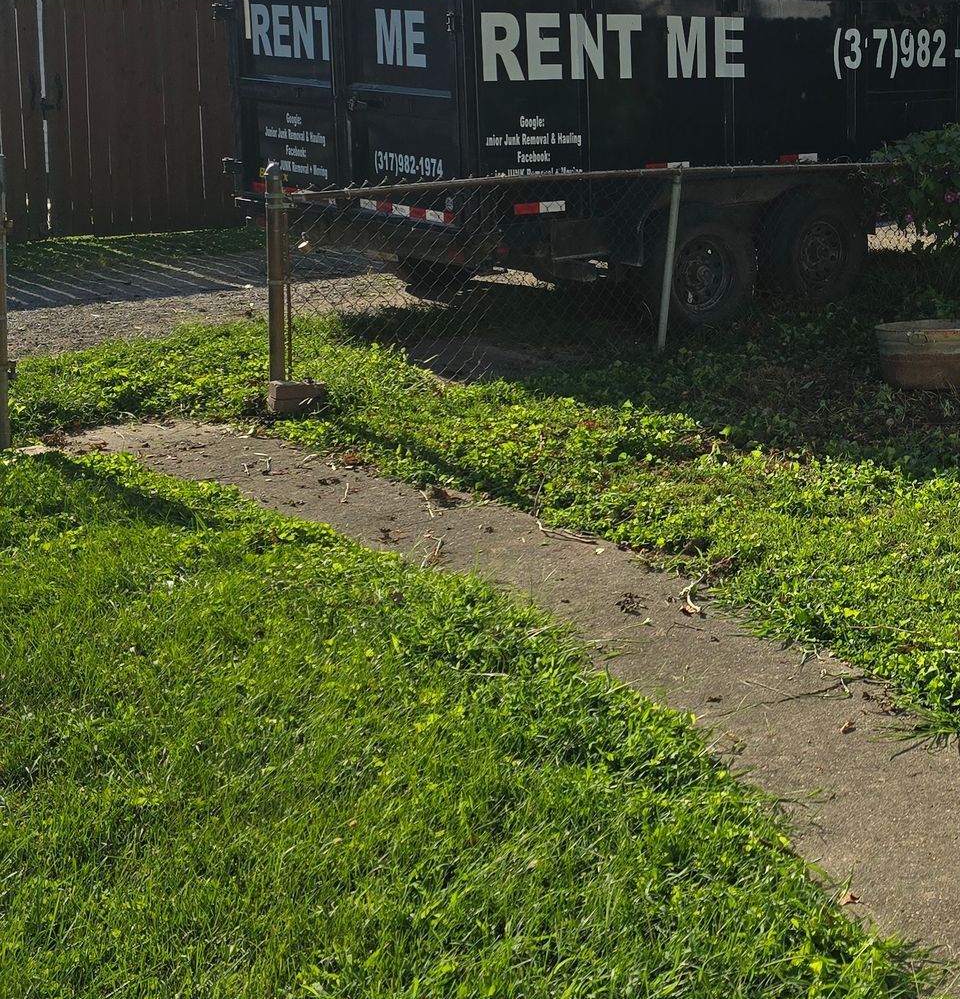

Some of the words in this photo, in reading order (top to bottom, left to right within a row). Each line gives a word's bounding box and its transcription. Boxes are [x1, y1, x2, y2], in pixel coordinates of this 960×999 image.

[250, 3, 330, 61] RENT
[375, 8, 427, 68] ME
[480, 12, 643, 82] RENT
[666, 15, 746, 79] ME
[285, 112, 302, 127] Google:
[519, 115, 545, 130] Google:
[504, 133, 521, 146] Junk
[522, 132, 550, 145] Removal
[550, 132, 556, 145] &
[557, 132, 582, 147] Hauling
[375, 150, 444, 177] (317)982-1974
[517, 150, 551, 163] Facebook:
